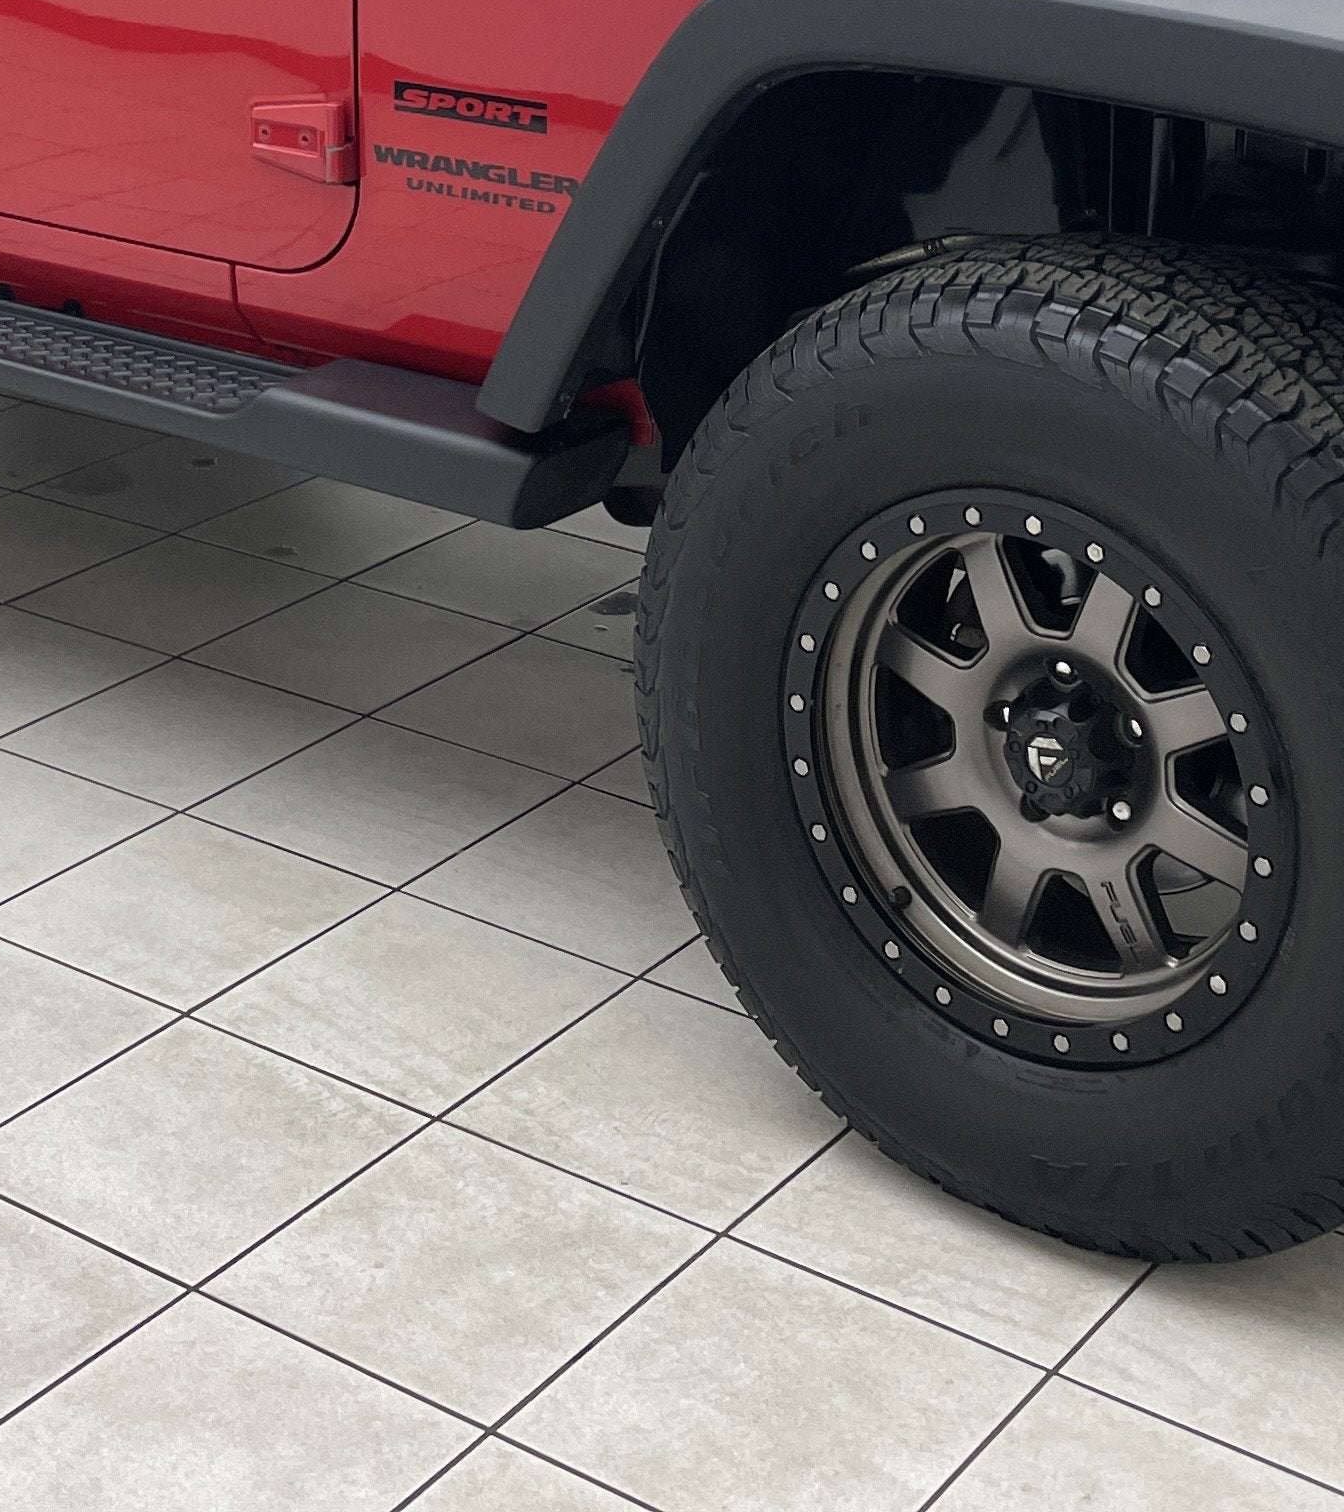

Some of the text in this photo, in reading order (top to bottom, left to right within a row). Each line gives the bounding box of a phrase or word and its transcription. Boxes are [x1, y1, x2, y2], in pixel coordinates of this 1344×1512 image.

[398, 87, 547, 126] SPORT
[373, 143, 580, 196] WRANGLER
[406, 176, 556, 215] UNLIMITED
